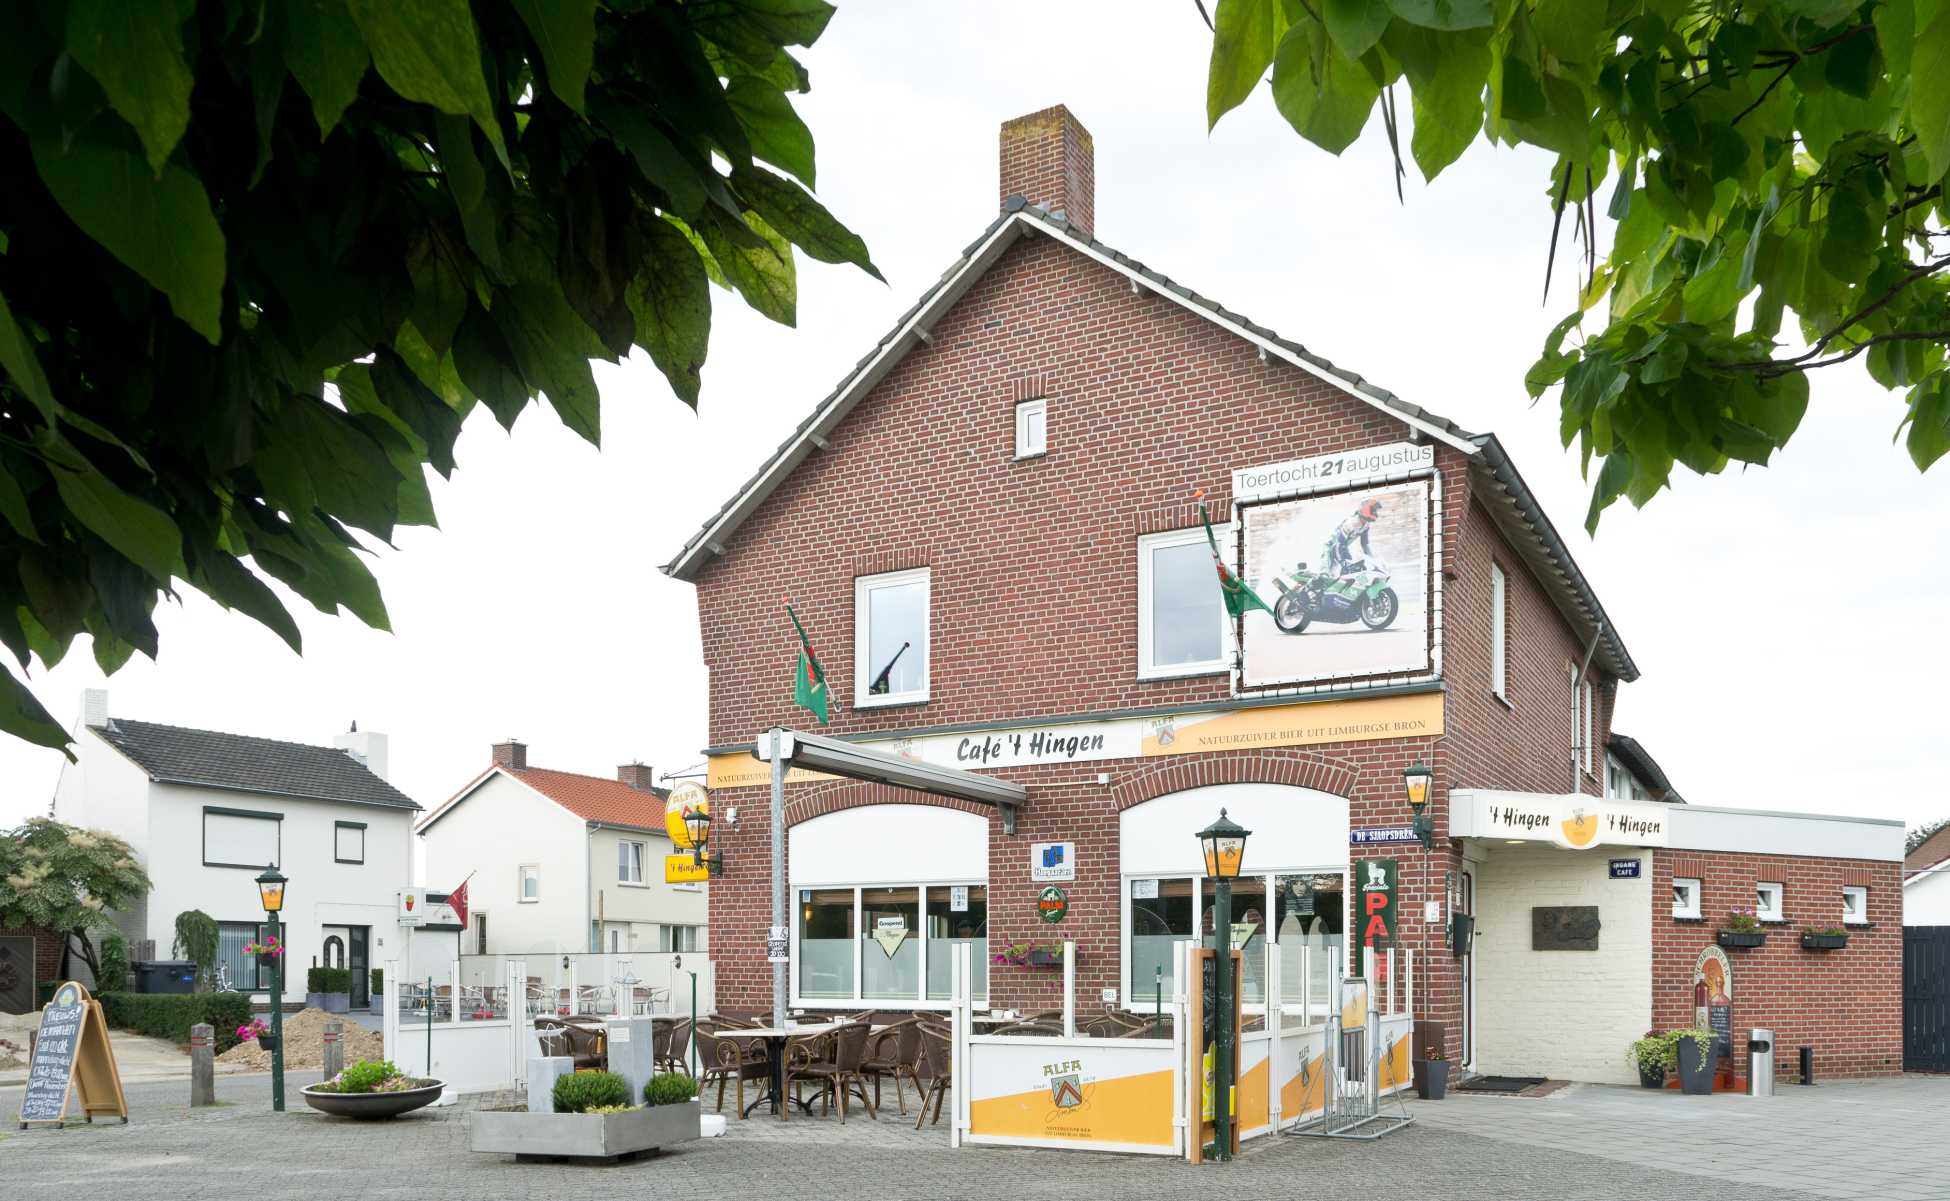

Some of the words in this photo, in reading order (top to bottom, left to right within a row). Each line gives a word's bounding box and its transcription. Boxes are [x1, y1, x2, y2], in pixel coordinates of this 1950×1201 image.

[1239, 465, 1318, 489] Toertocht
[1321, 459, 1344, 477] 21
[1346, 446, 1432, 472] augustus
[1199, 730, 1277, 746] NATUURZUIVER
[1280, 729, 1303, 740] BIER
[1308, 727, 1324, 738] UIT
[1328, 723, 1391, 737] LIMBURGSE
[1394, 720, 1426, 731] BRON
[957, 736, 1001, 764] Café
[1008, 734, 1021, 756] 't
[1029, 731, 1104, 758] Hingen
[1490, 805, 1498, 824] 't
[1503, 807, 1549, 830] Hingen
[1607, 813, 1614, 830] 't
[1619, 815, 1660, 837] Hingen
[1356, 831, 1365, 841] DE
[1043, 1060, 1082, 1076] ALFA
